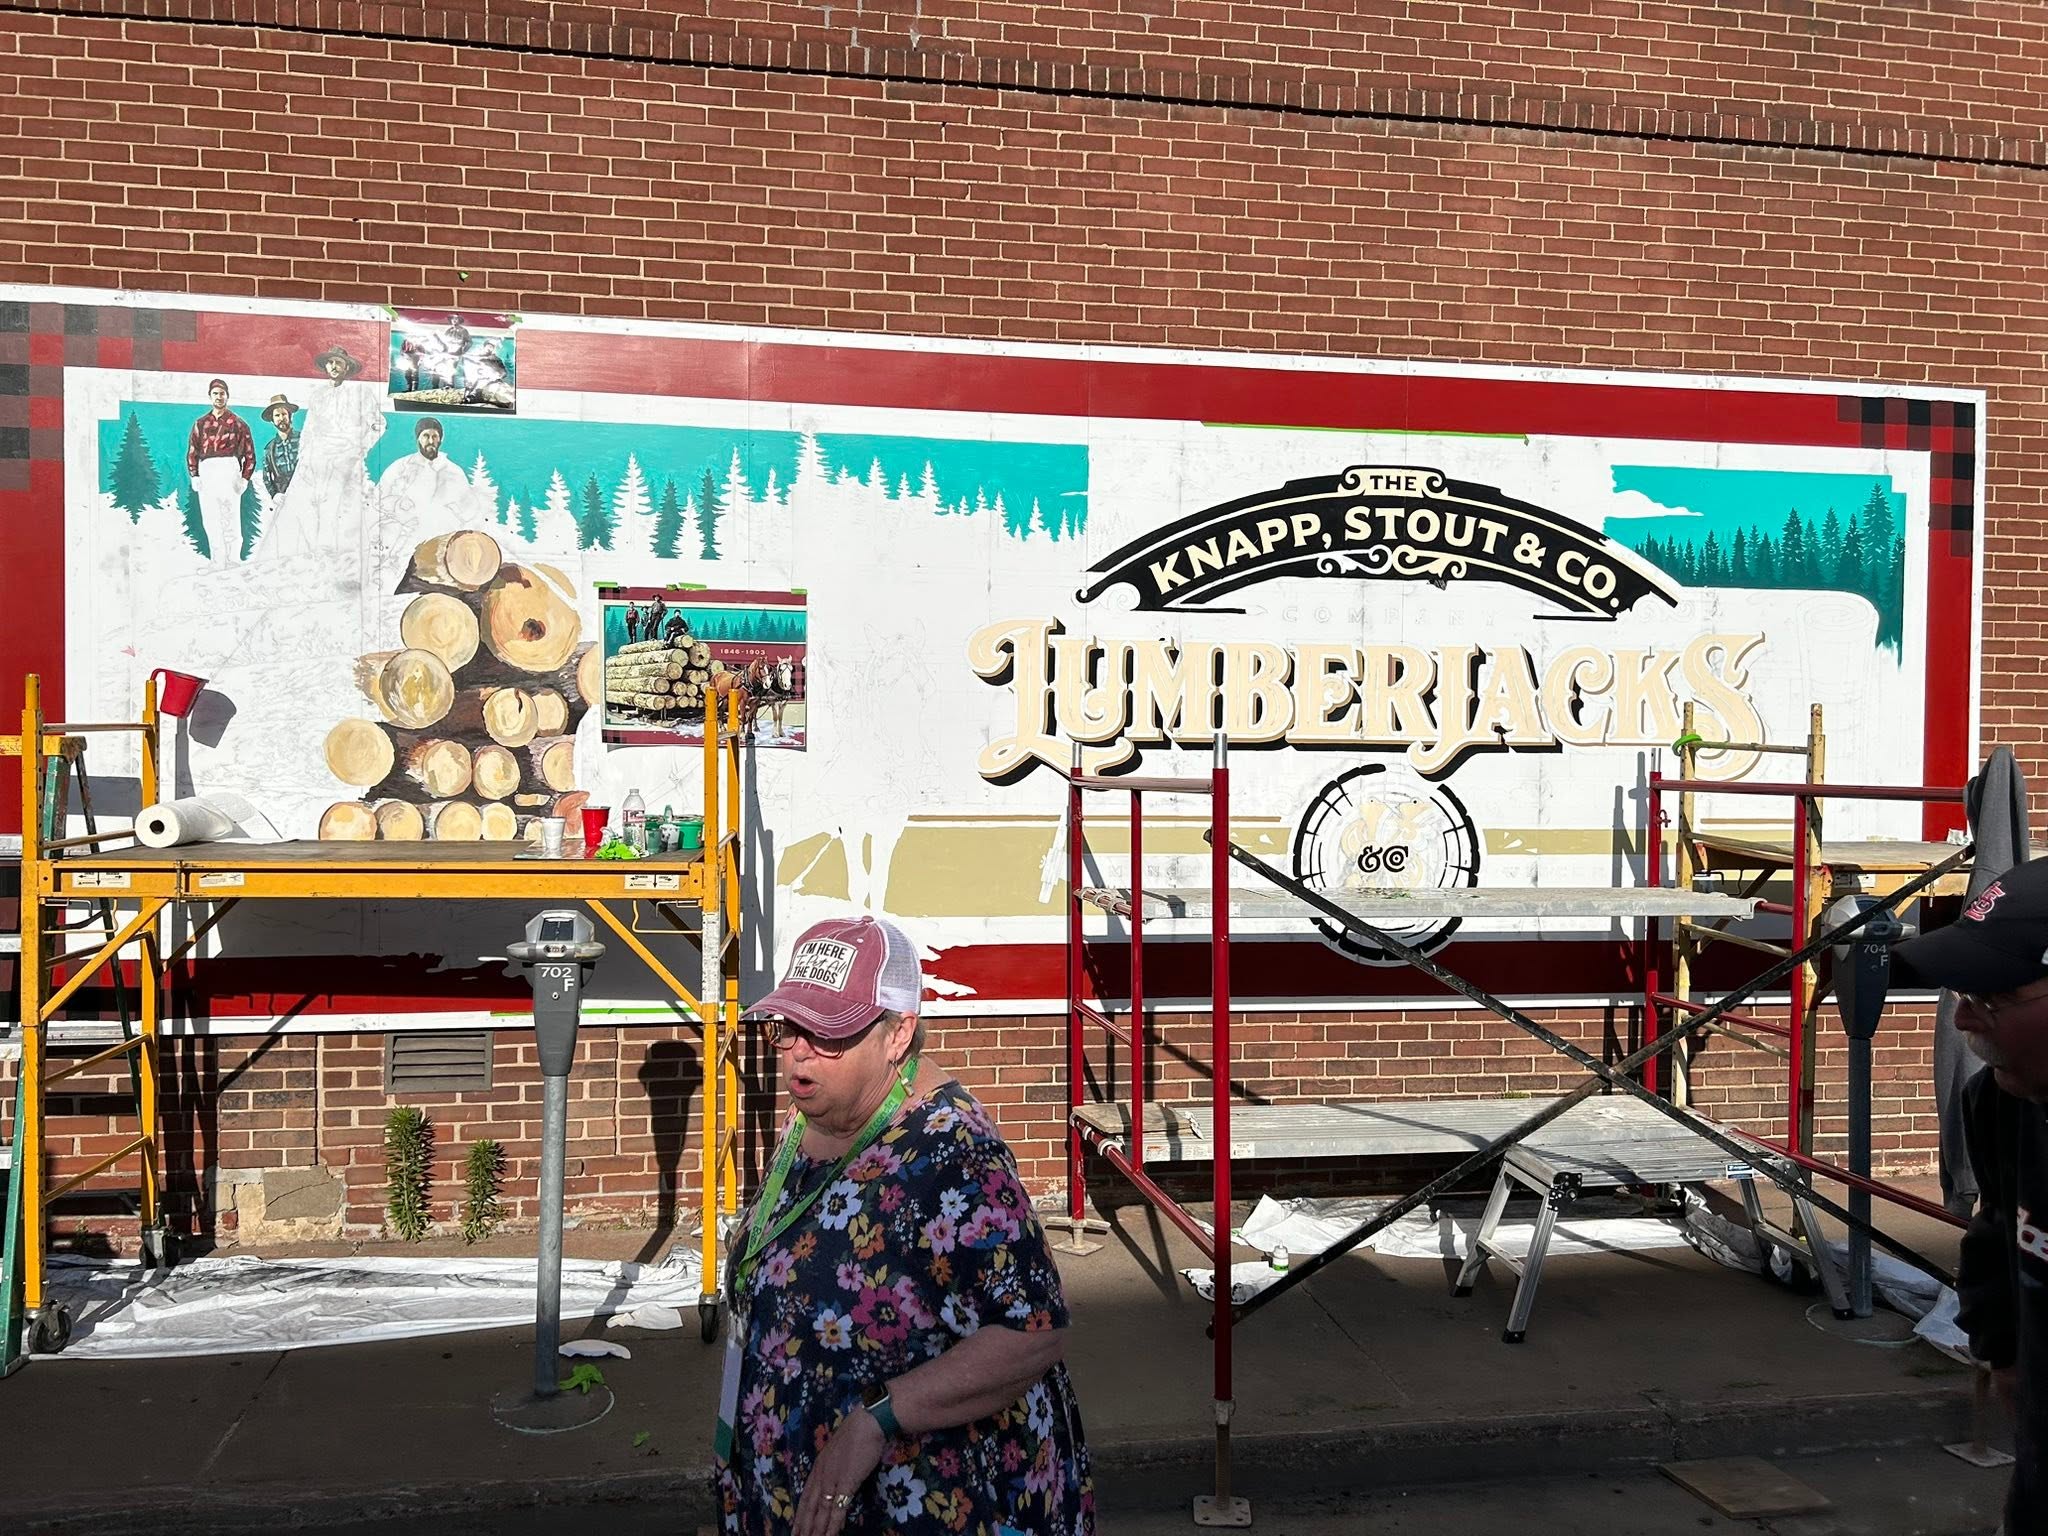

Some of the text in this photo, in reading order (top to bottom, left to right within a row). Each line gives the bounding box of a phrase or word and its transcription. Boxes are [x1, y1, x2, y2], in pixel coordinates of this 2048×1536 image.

[1369, 474, 1417, 491] THE
[1148, 505, 1620, 608] KNAPP, STOUT & CO.
[720, 648, 766, 656] 1846-1903
[968, 616, 1766, 786] LUMBERJACKS
[802, 943, 847, 960] I'M HERE
[1863, 943, 1887, 954] 704
[807, 954, 827, 967] Pet
[827, 960, 848, 973] All
[1880, 954, 1889, 967] F
[541, 966, 572, 978] 702
[794, 966, 838, 985] THE DOGS
[564, 978, 575, 992] F
